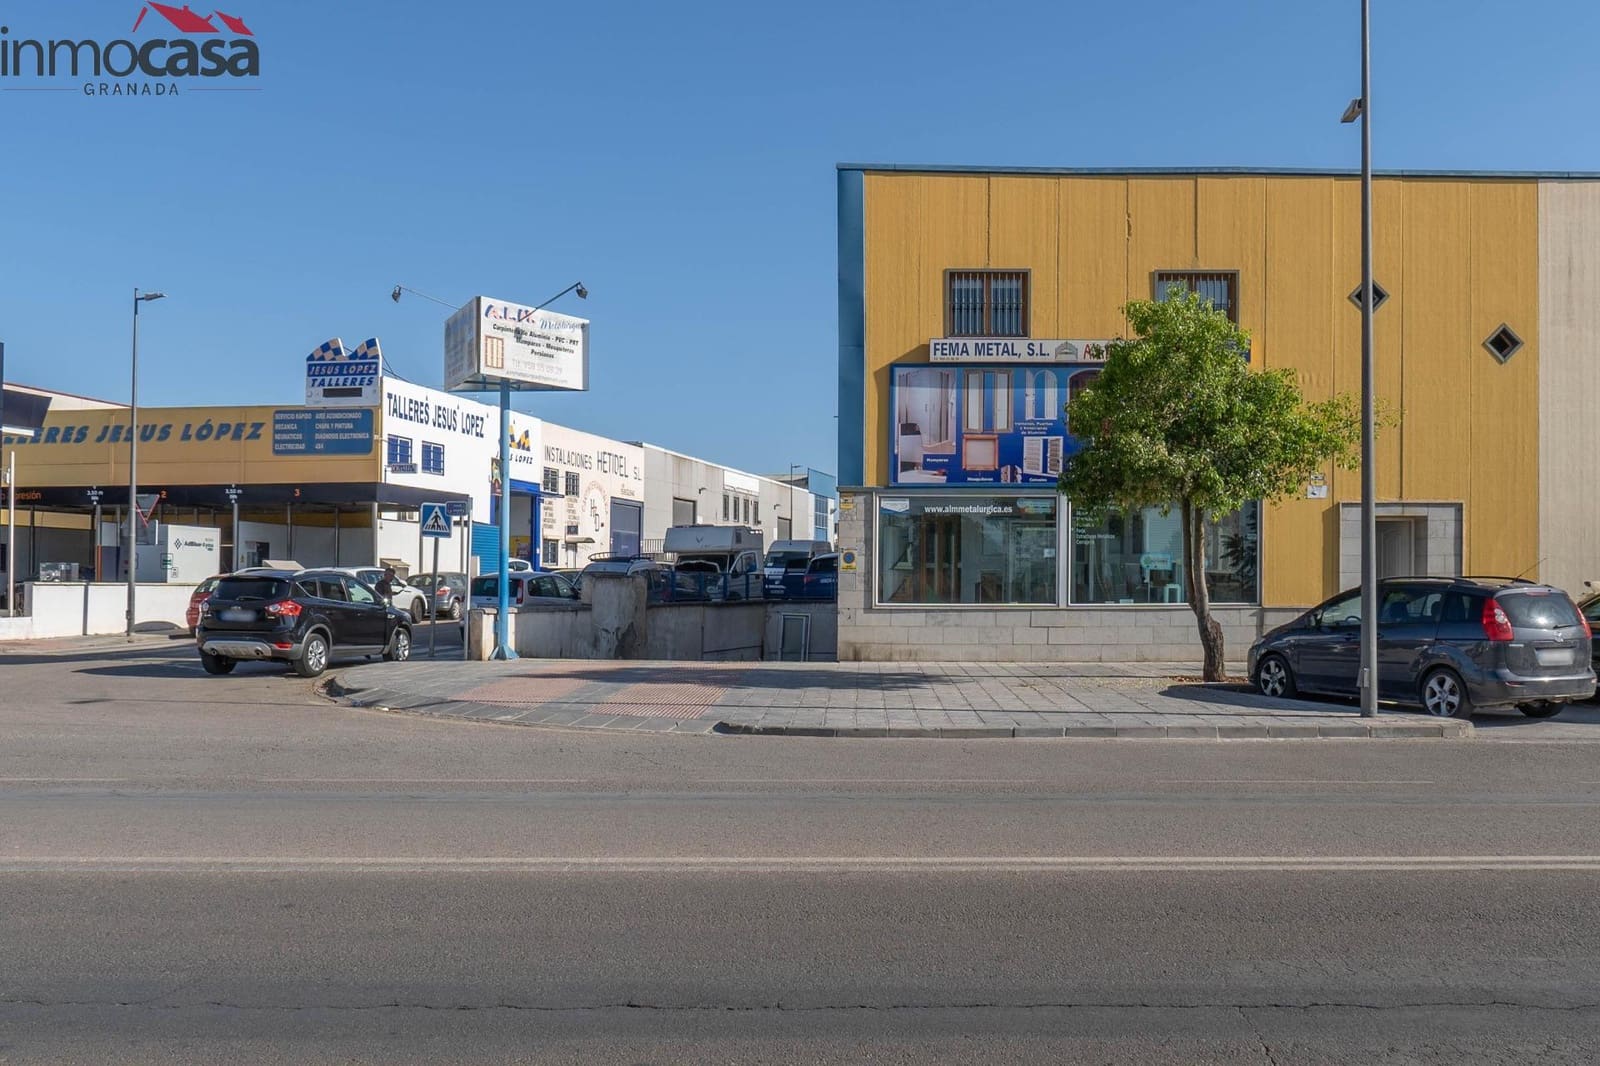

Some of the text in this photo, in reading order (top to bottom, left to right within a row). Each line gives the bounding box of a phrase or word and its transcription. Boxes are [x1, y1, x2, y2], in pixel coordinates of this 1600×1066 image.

[933, 342, 1050, 359] FEMA METAL, S.L.
[311, 376, 375, 387] TALLERES
[387, 392, 485, 438] TALLERES JESUS LOPEZ
[180, 418, 266, 442] LÓPEZ
[544, 444, 593, 470] INSTALACIONES
[294, 488, 300, 497] 3
